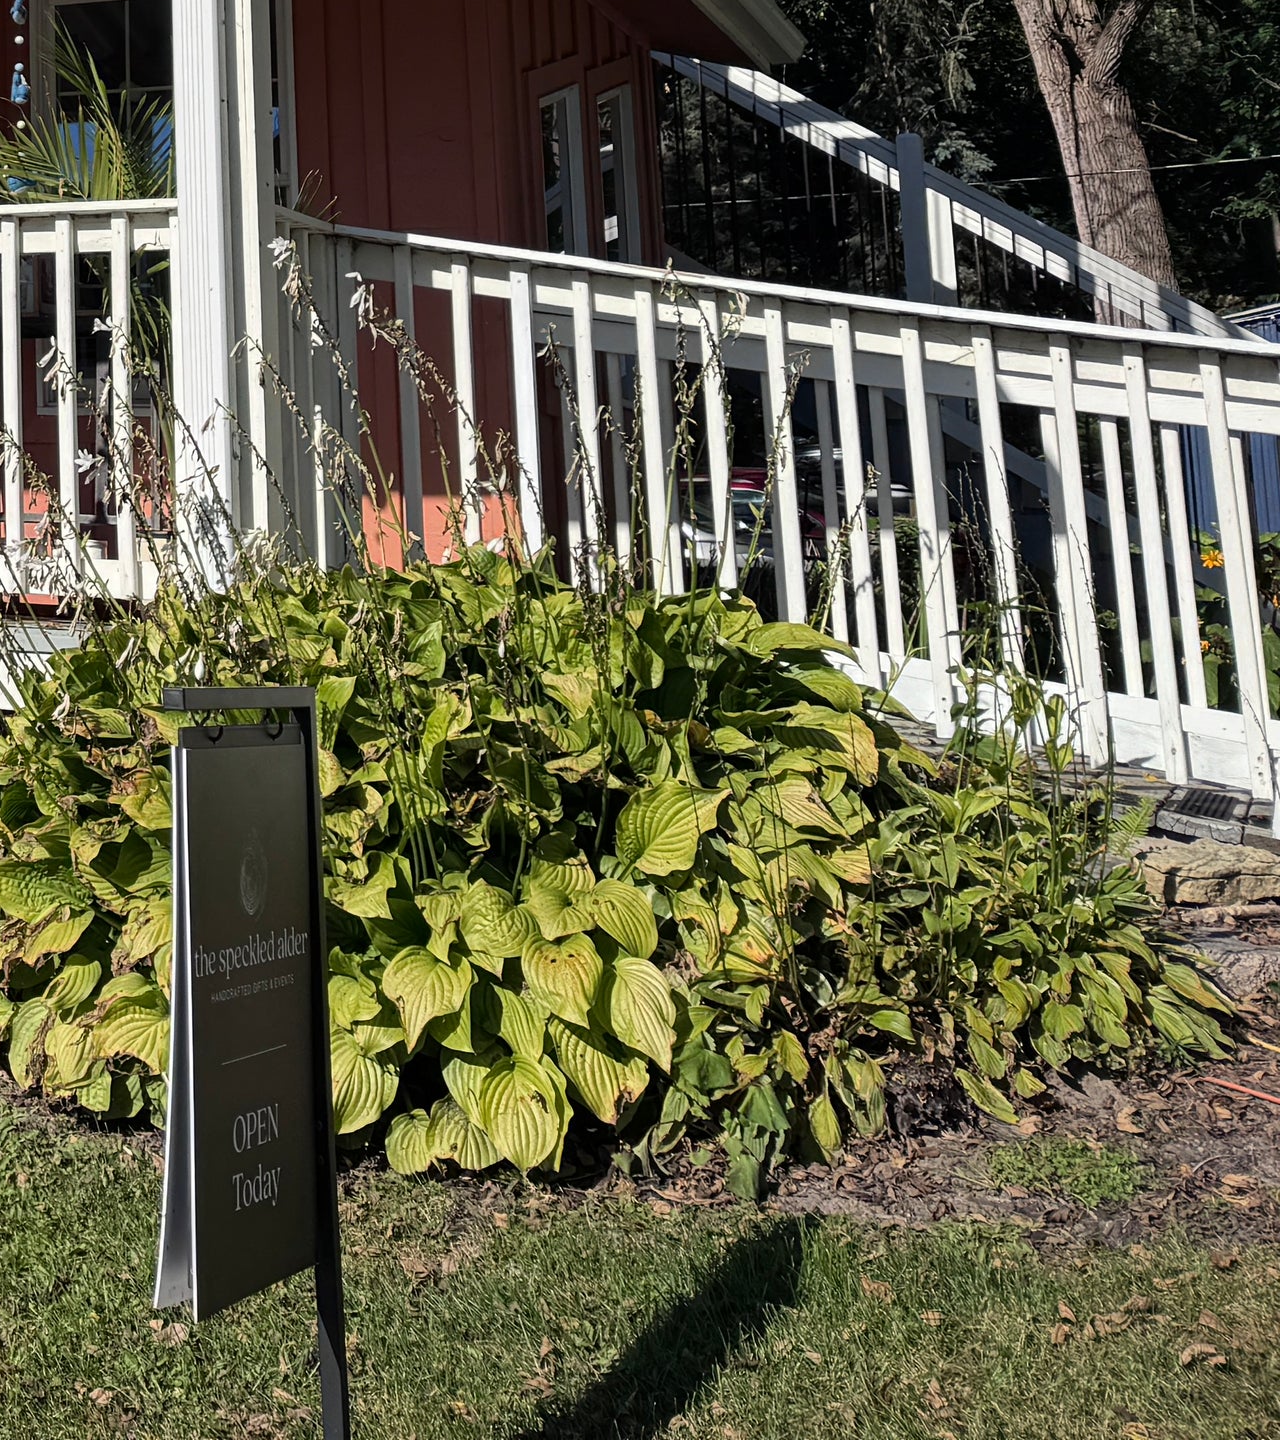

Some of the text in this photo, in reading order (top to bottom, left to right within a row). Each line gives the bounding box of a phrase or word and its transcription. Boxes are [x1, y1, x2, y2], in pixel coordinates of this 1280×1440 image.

[194, 926, 308, 980] the speckled alder
[232, 1103, 279, 1153] OPEN
[232, 1163, 281, 1211] Today
